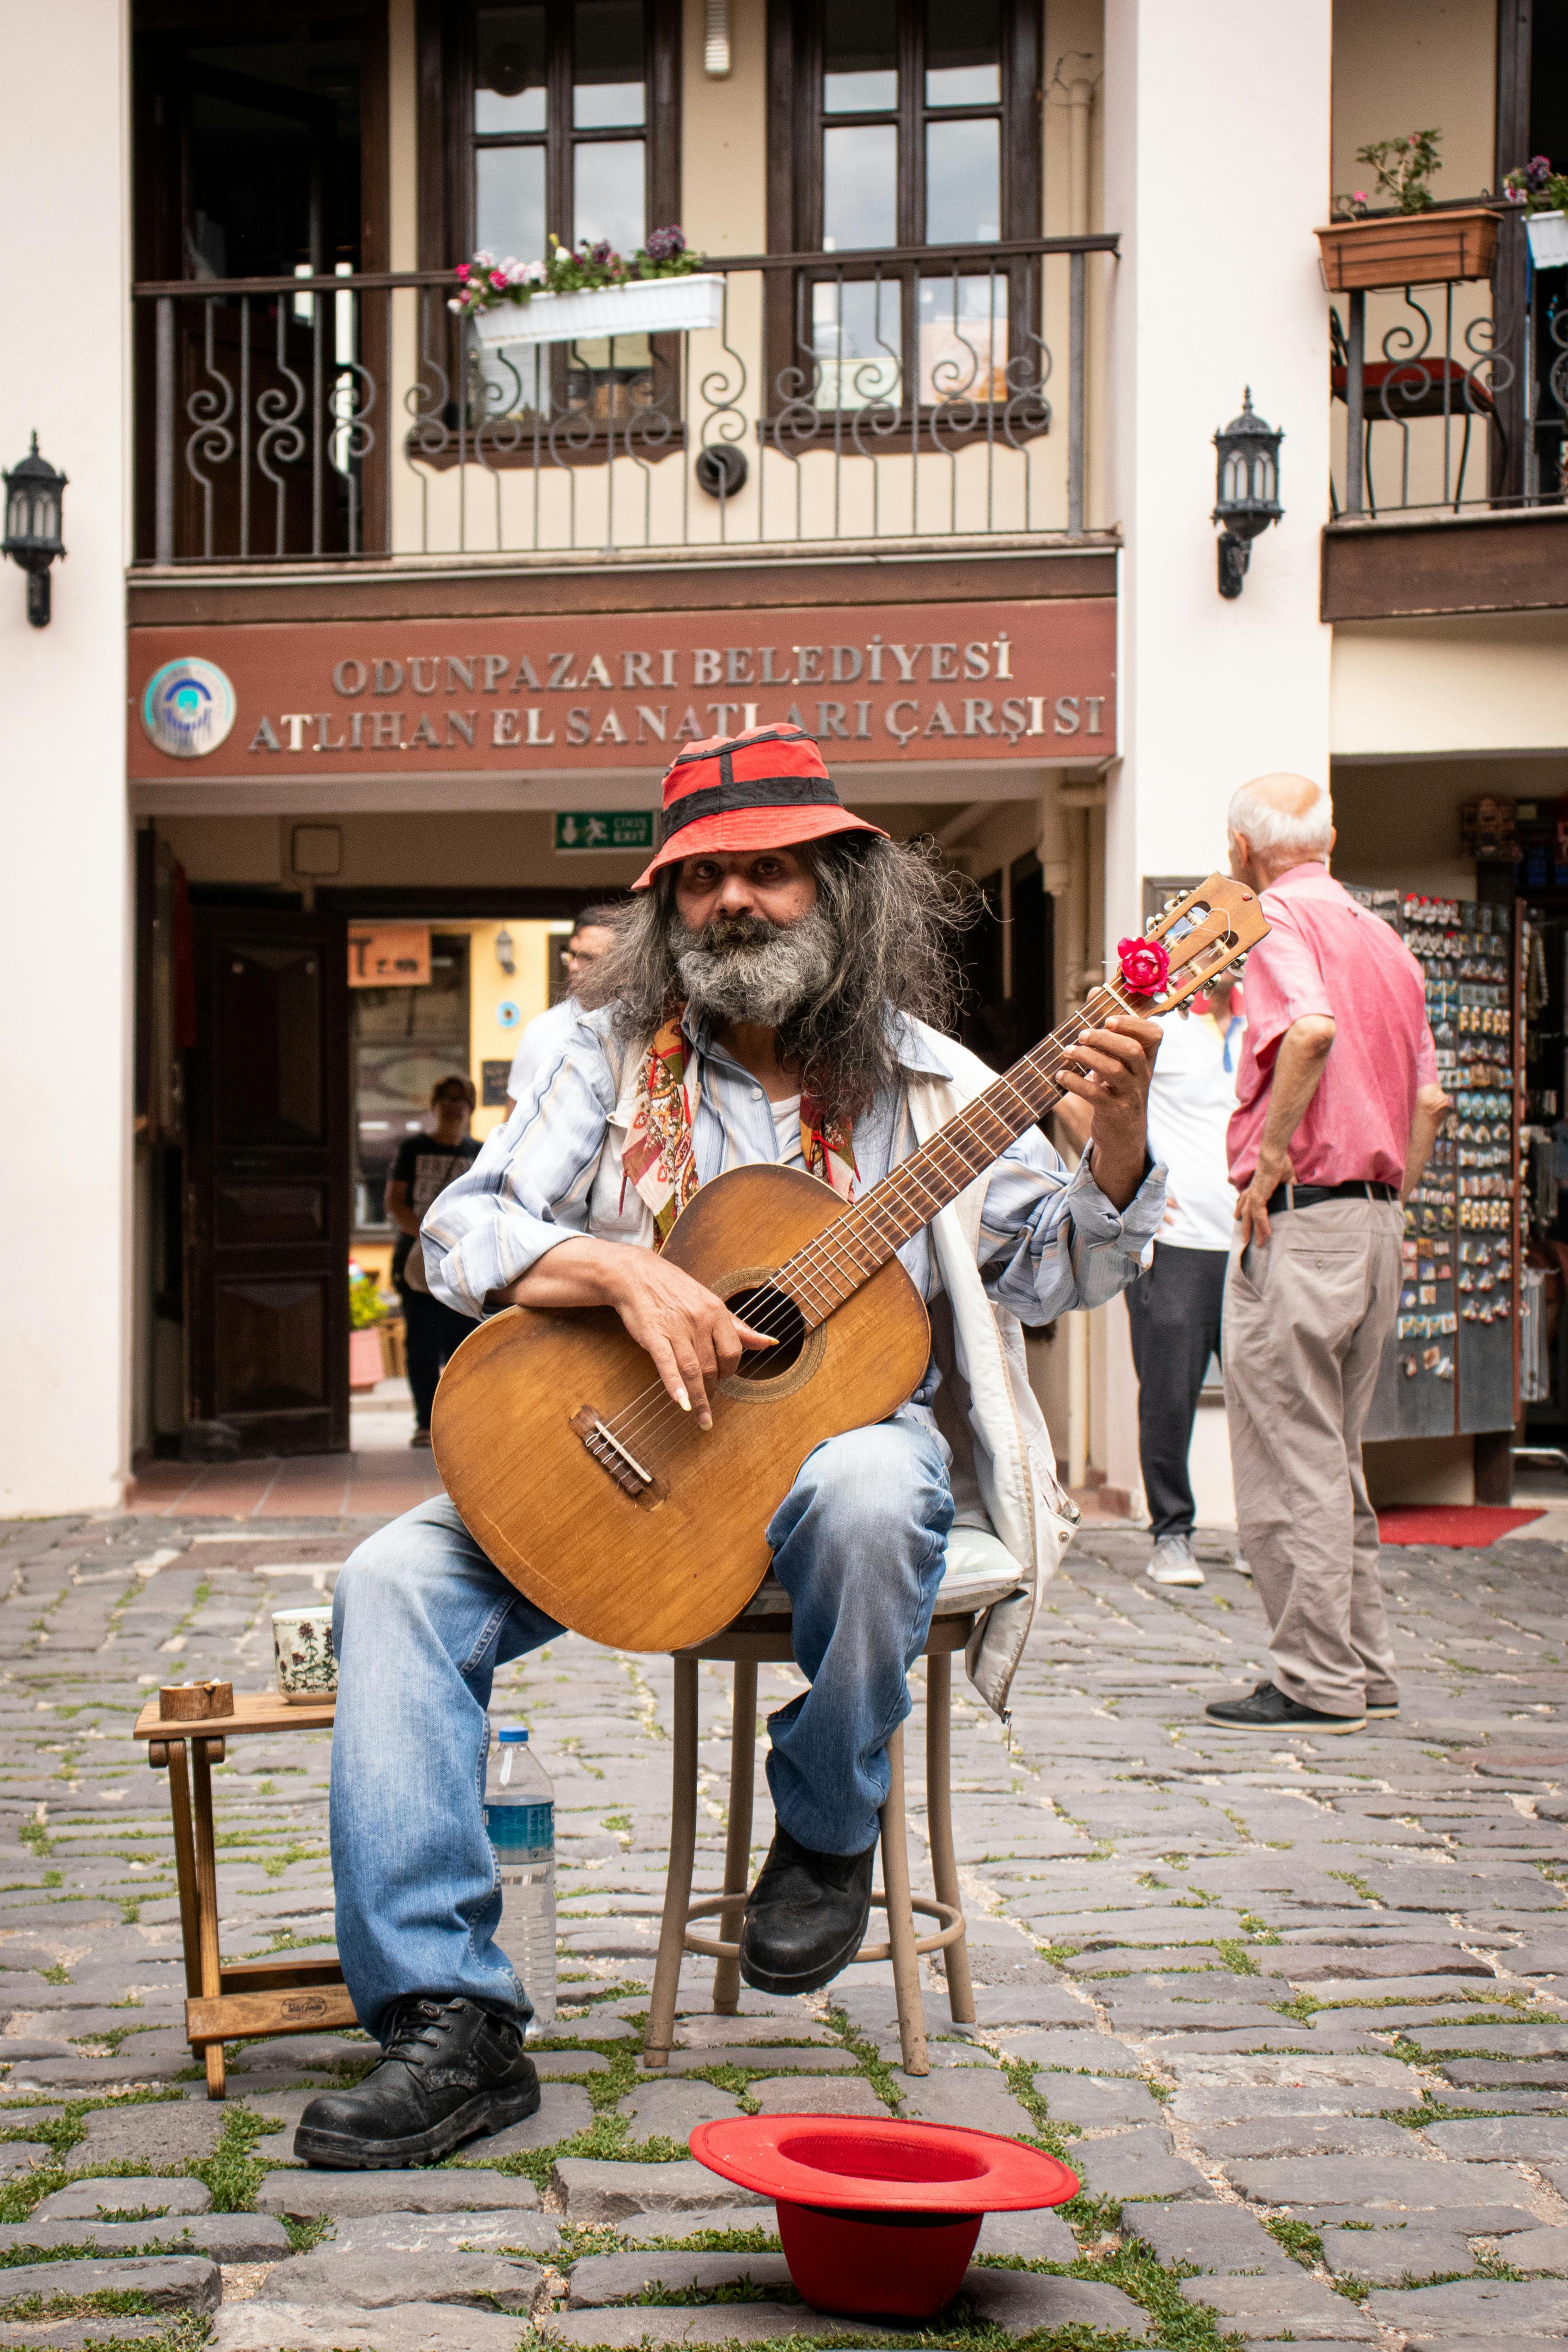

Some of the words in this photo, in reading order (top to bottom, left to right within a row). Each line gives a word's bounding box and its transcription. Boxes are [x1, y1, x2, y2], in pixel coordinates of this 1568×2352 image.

[332, 650, 678, 697] ODUNPAZARI
[693, 632, 1013, 687] BELEDİYESİ
[248, 710, 478, 753] ATLIHAN
[492, 707, 555, 747] EL
[884, 695, 1105, 747] ÇARŞISI
